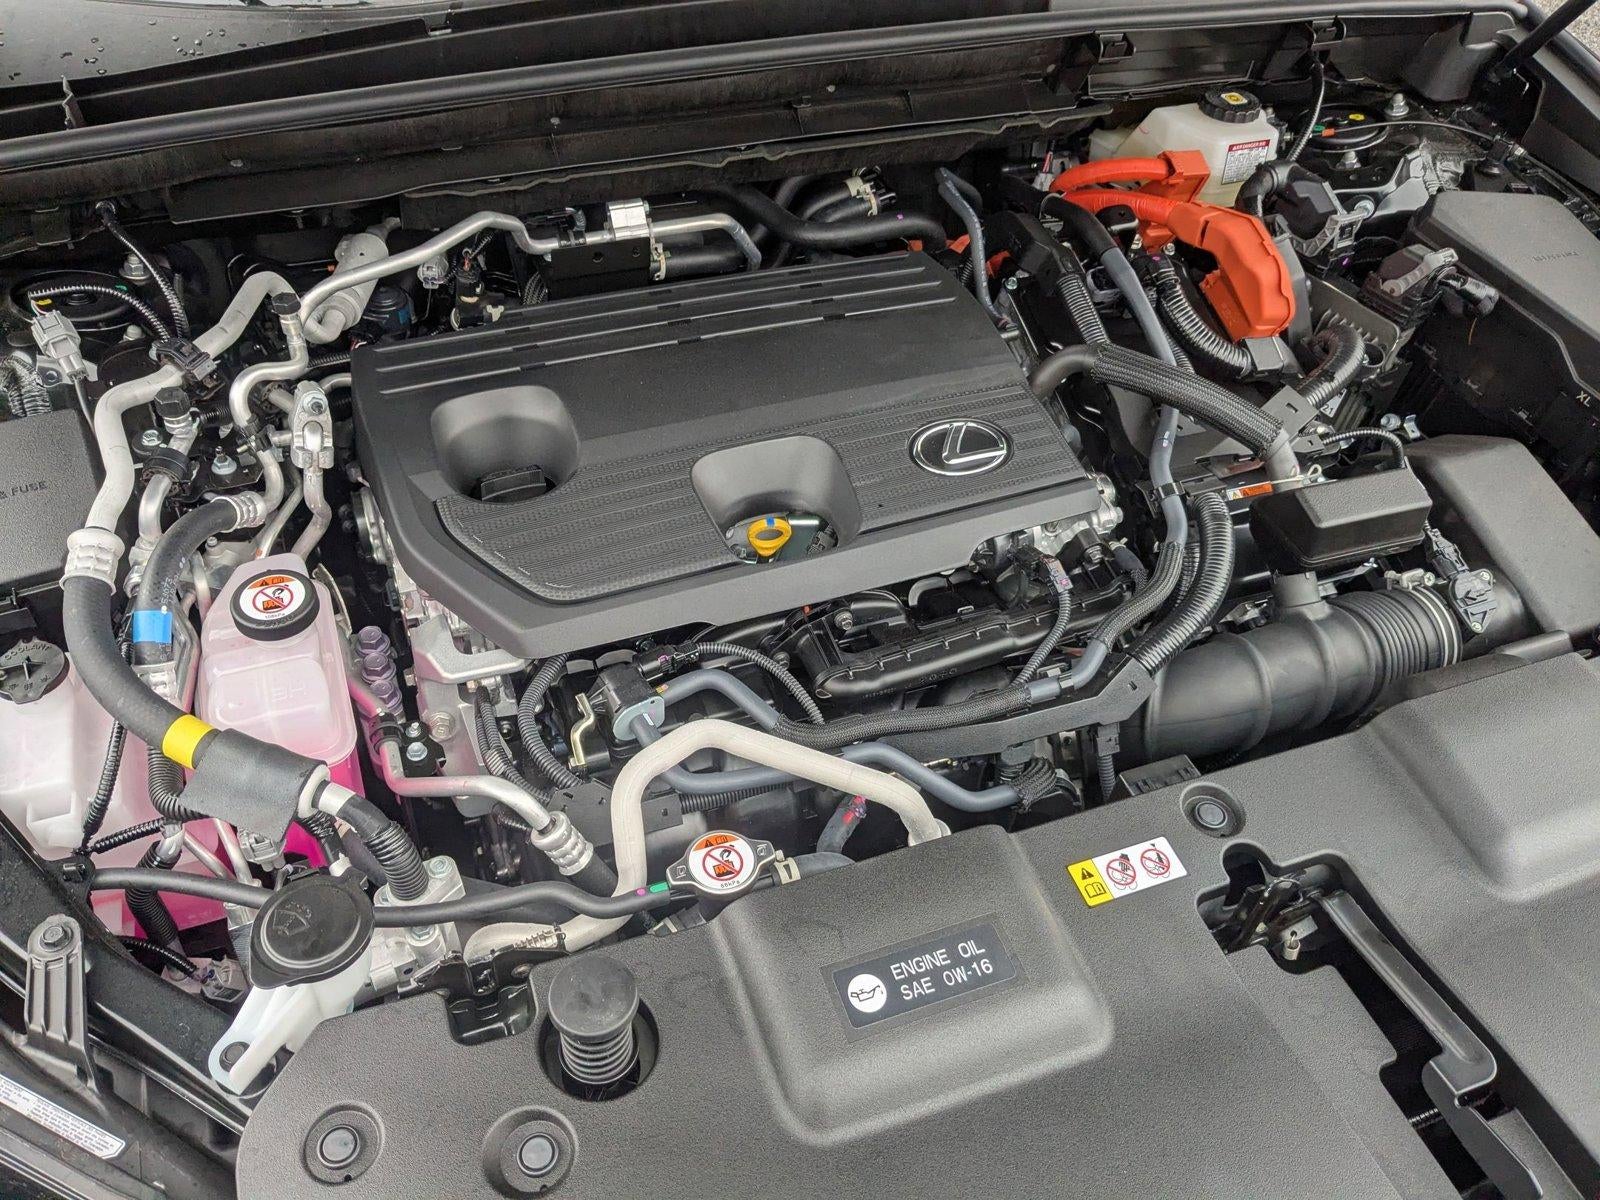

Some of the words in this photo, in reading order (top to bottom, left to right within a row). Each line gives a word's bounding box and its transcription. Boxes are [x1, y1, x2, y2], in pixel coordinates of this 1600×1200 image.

[11, 480, 48, 496] FUSE
[890, 948, 951, 980] ENGINE
[957, 939, 986, 959] OIL
[900, 977, 936, 1001] SAE
[942, 958, 994, 986] 0W-16
